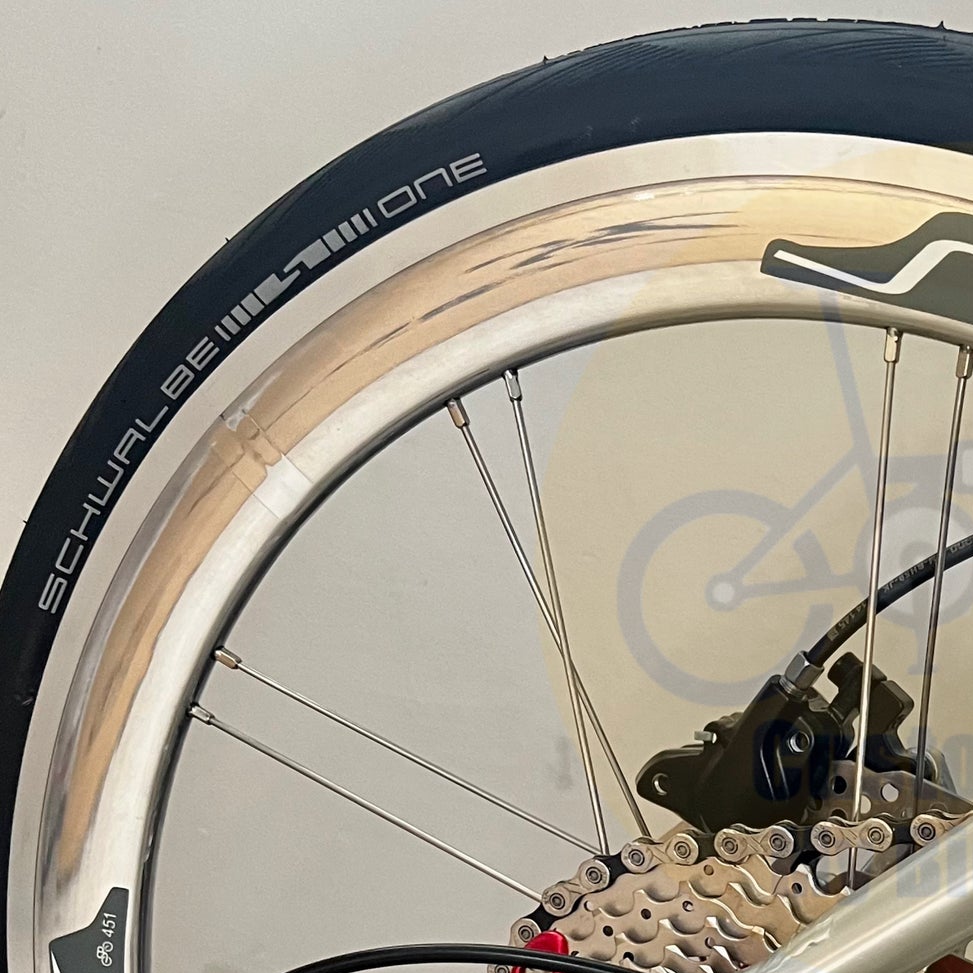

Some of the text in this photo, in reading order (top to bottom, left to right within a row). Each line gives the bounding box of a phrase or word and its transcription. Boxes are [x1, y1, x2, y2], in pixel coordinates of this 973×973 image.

[38, 153, 487, 614] SCHWALBE ONE
[102, 912, 118, 938] 451
